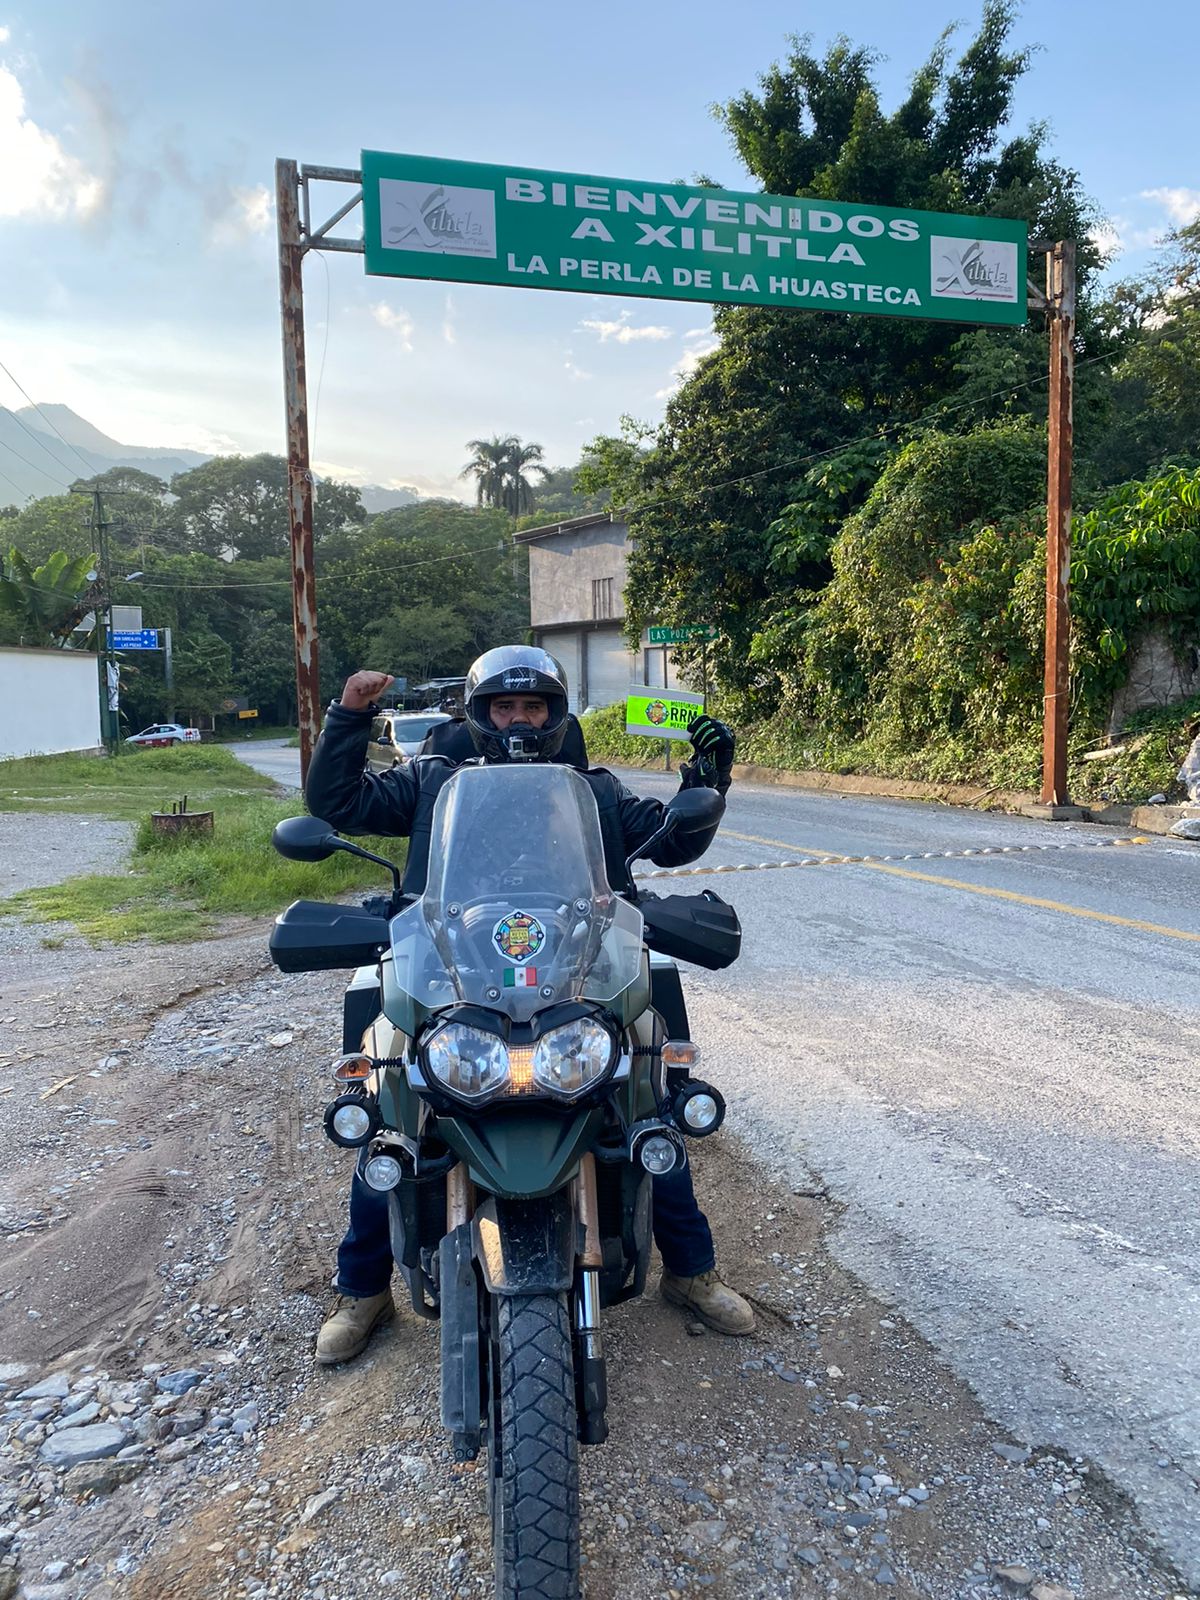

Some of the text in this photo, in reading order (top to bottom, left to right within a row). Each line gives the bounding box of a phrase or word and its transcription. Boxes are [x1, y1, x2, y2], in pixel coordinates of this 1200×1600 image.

[505, 177, 920, 242] BIENVENIDOS
[572, 218, 865, 268] A XILITLA
[507, 254, 921, 306] LA PERLA DE LA HUASTECA
[651, 629, 666, 641] LAS
[670, 706, 698, 723] RRM
